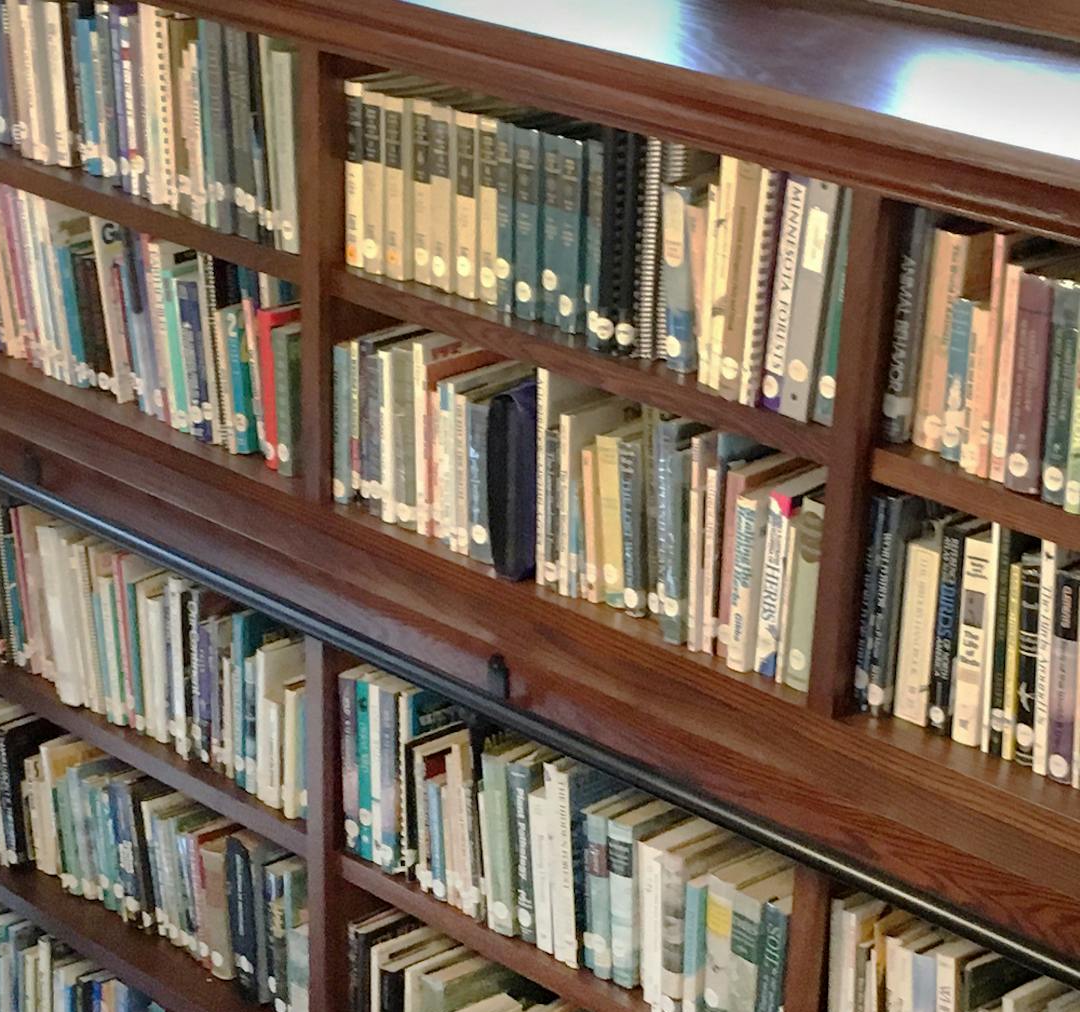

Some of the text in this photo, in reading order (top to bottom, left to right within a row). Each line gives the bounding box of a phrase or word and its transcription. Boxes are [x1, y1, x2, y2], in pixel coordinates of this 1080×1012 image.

[772, 186, 805, 370] MINNESOTA FORESTS
[895, 254, 917, 319] ANIMAL
[762, 564, 781, 622] HERBS
[936, 584, 956, 639] BIRDS
[516, 787, 526, 819] Plant
[518, 821, 528, 881] Pathology
